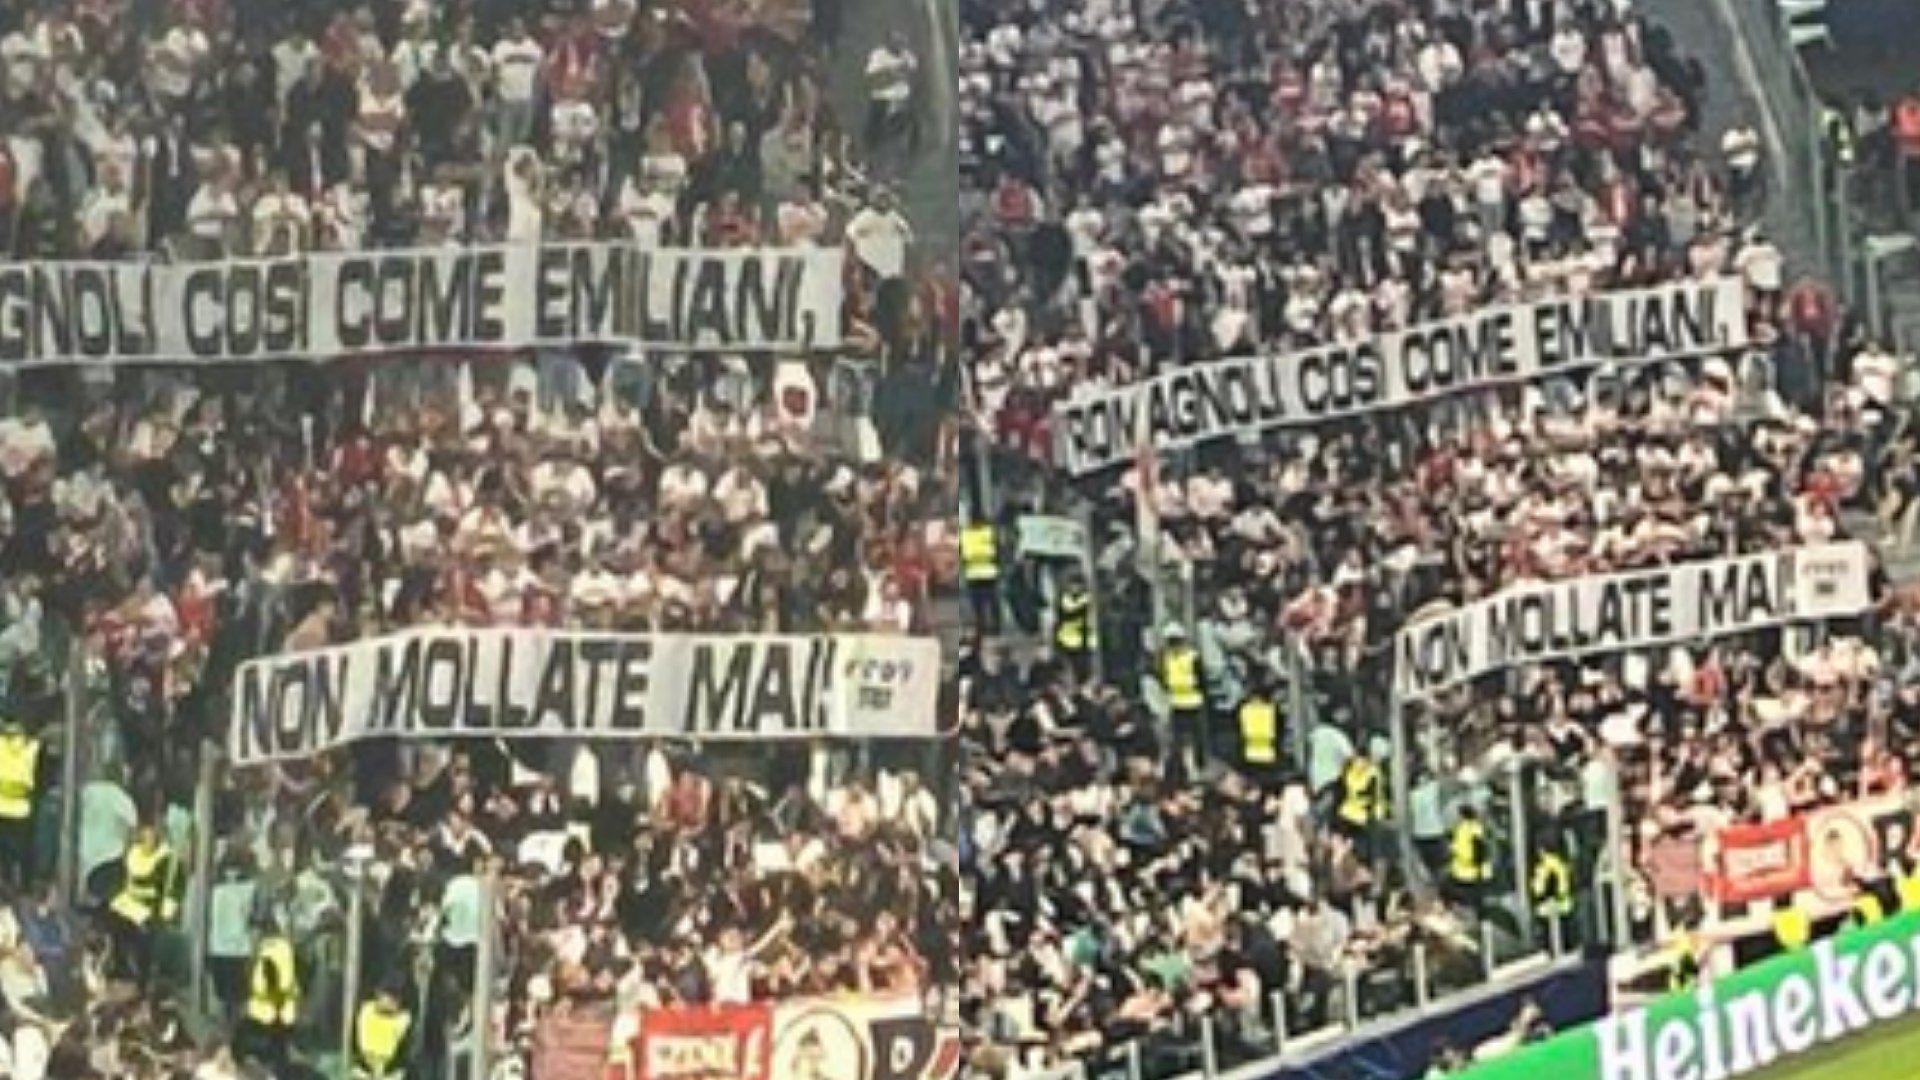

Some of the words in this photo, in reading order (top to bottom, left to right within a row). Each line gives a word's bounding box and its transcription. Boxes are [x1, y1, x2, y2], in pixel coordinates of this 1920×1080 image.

[335, 253, 505, 347] COME
[1403, 312, 1517, 392] COME
[1402, 612, 1468, 693] NON
[1486, 577, 1672, 660] MOLLATE
[240, 652, 348, 760] NON
[366, 635, 653, 729] MOLLATE
[1592, 935, 1920, 1080] Heineke
